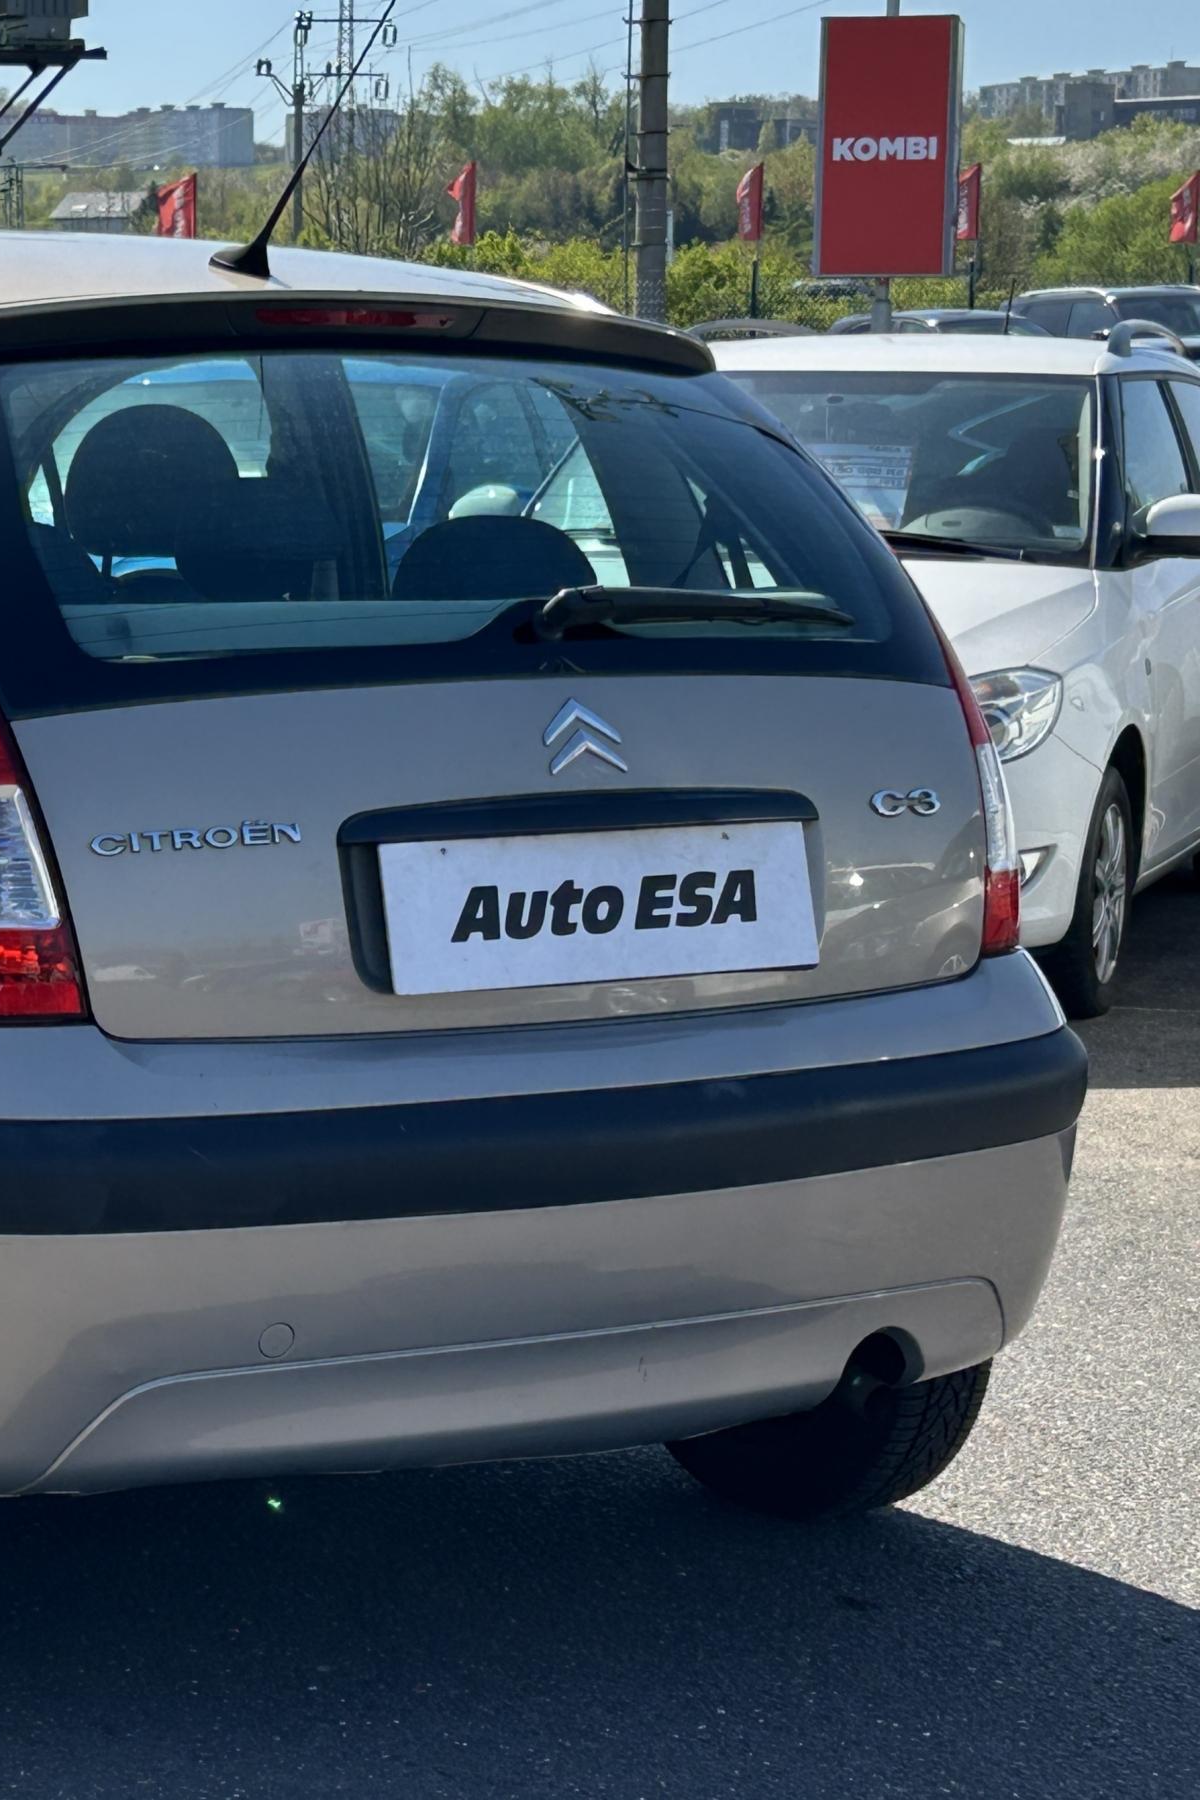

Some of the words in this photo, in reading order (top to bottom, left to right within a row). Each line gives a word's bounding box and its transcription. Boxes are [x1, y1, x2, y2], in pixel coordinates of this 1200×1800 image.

[832, 136, 938, 161] KOMBI
[869, 788, 941, 818] C3
[90, 819, 302, 857] CITROËN
[451, 879, 625, 943] Auto
[634, 869, 757, 930] ESA
